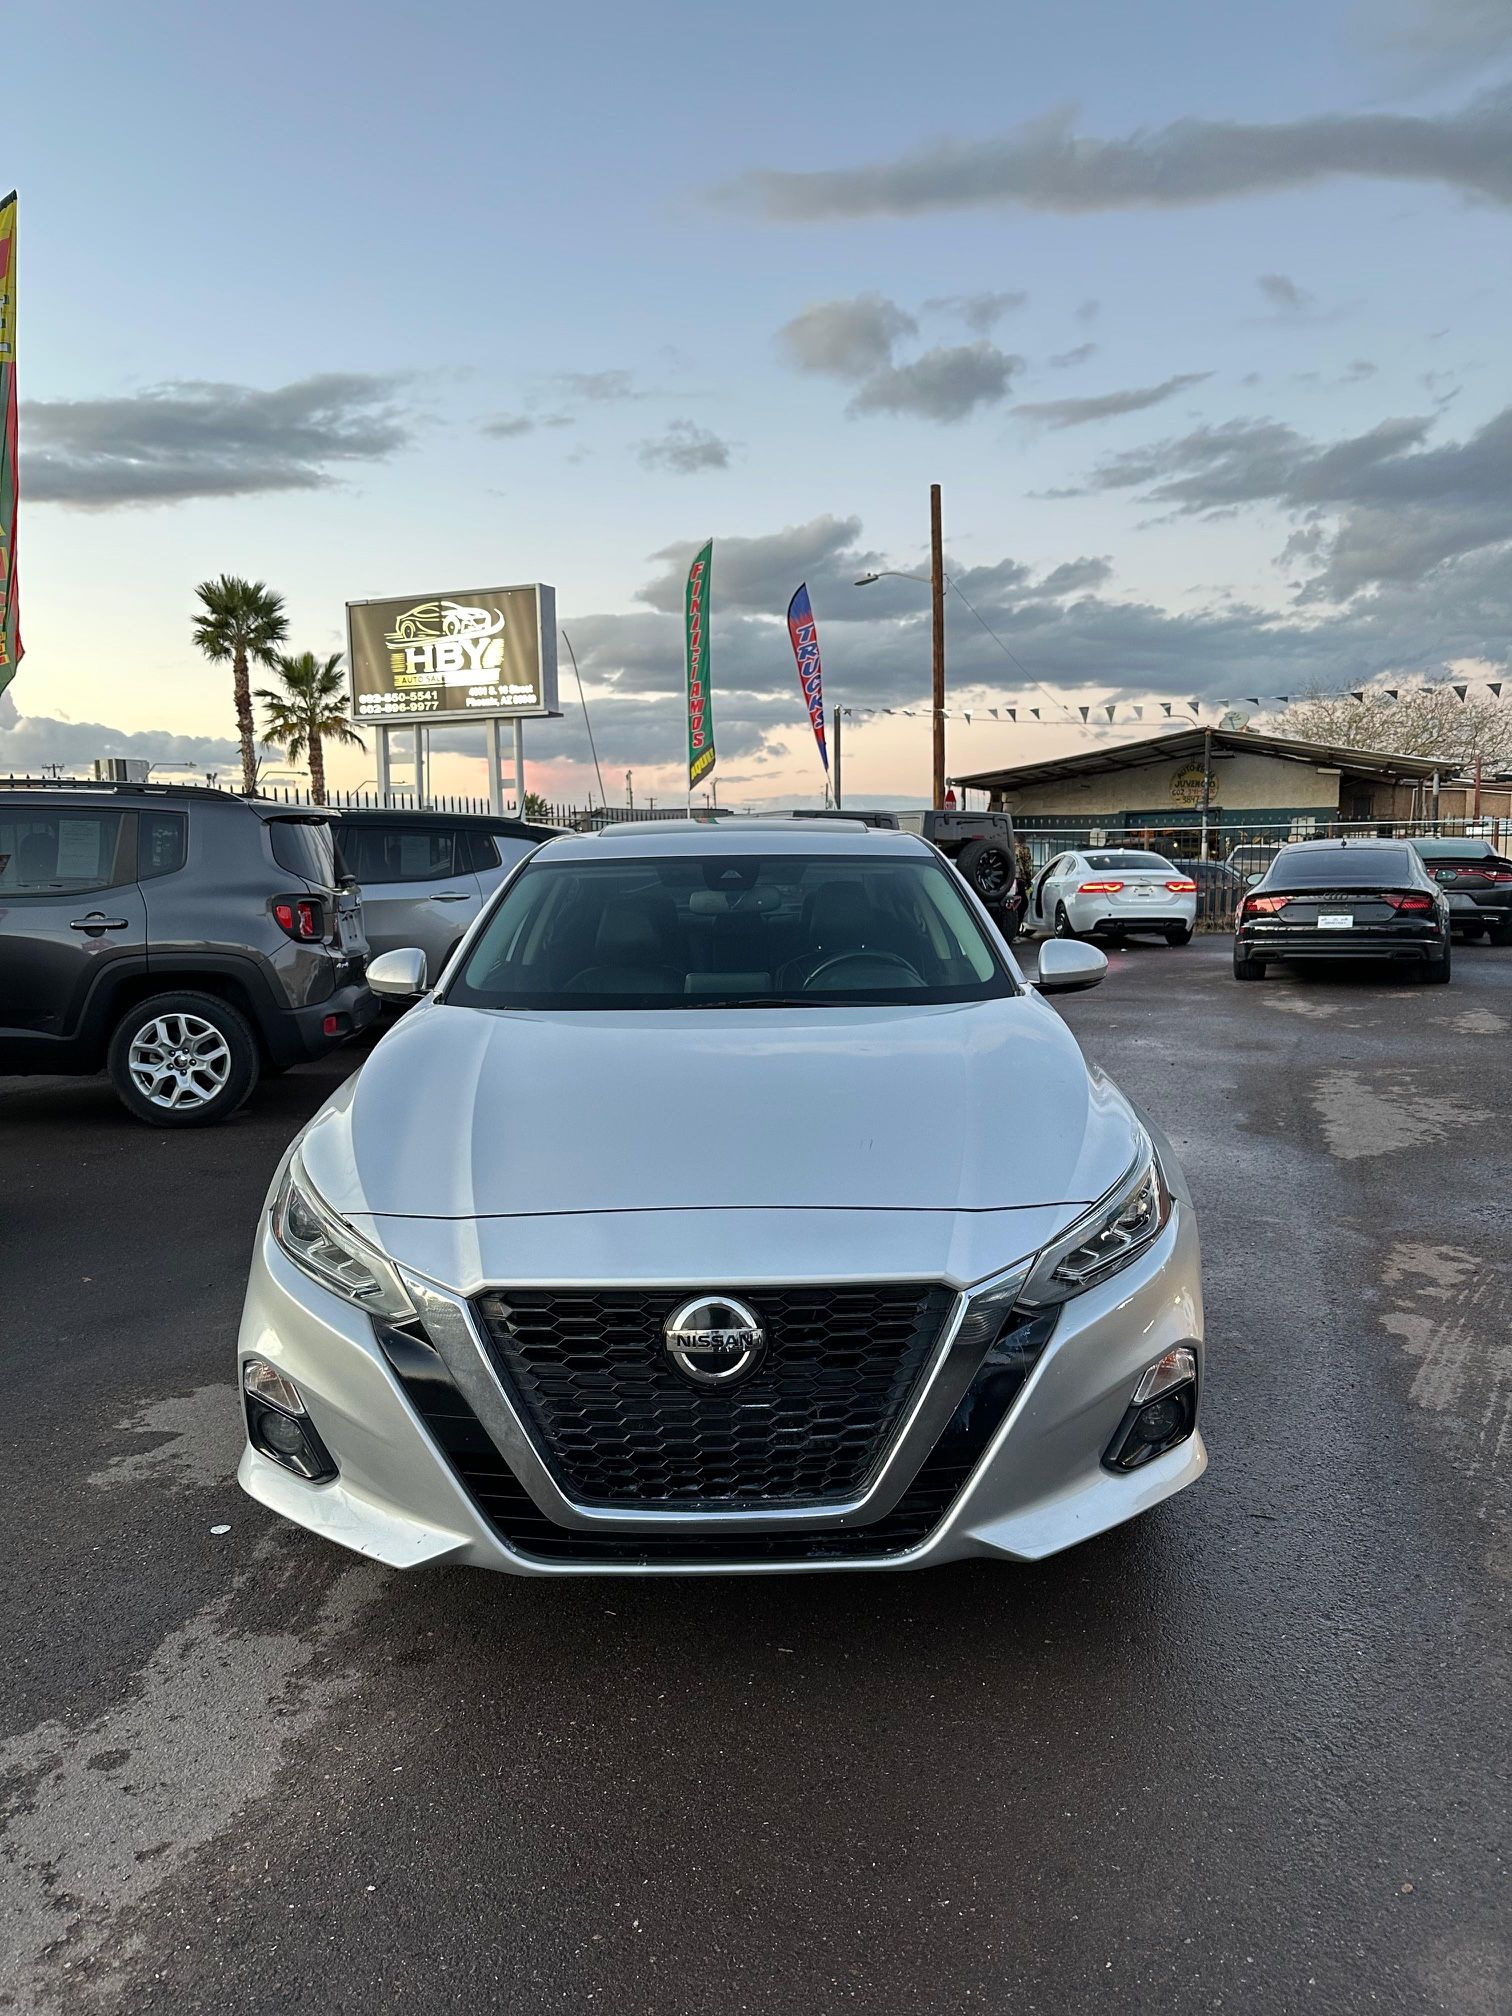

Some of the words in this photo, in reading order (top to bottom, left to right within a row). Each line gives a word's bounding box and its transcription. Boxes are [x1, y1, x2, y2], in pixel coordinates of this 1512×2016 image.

[405, 638, 492, 673] HBY
[690, 561, 704, 749] FINANCIAMOS
[402, 675, 424, 684] AUTO
[796, 622, 825, 729] TRUCKS
[1174, 780, 1216, 788] JUVENCO
[676, 1333, 753, 1347] NISSAN
